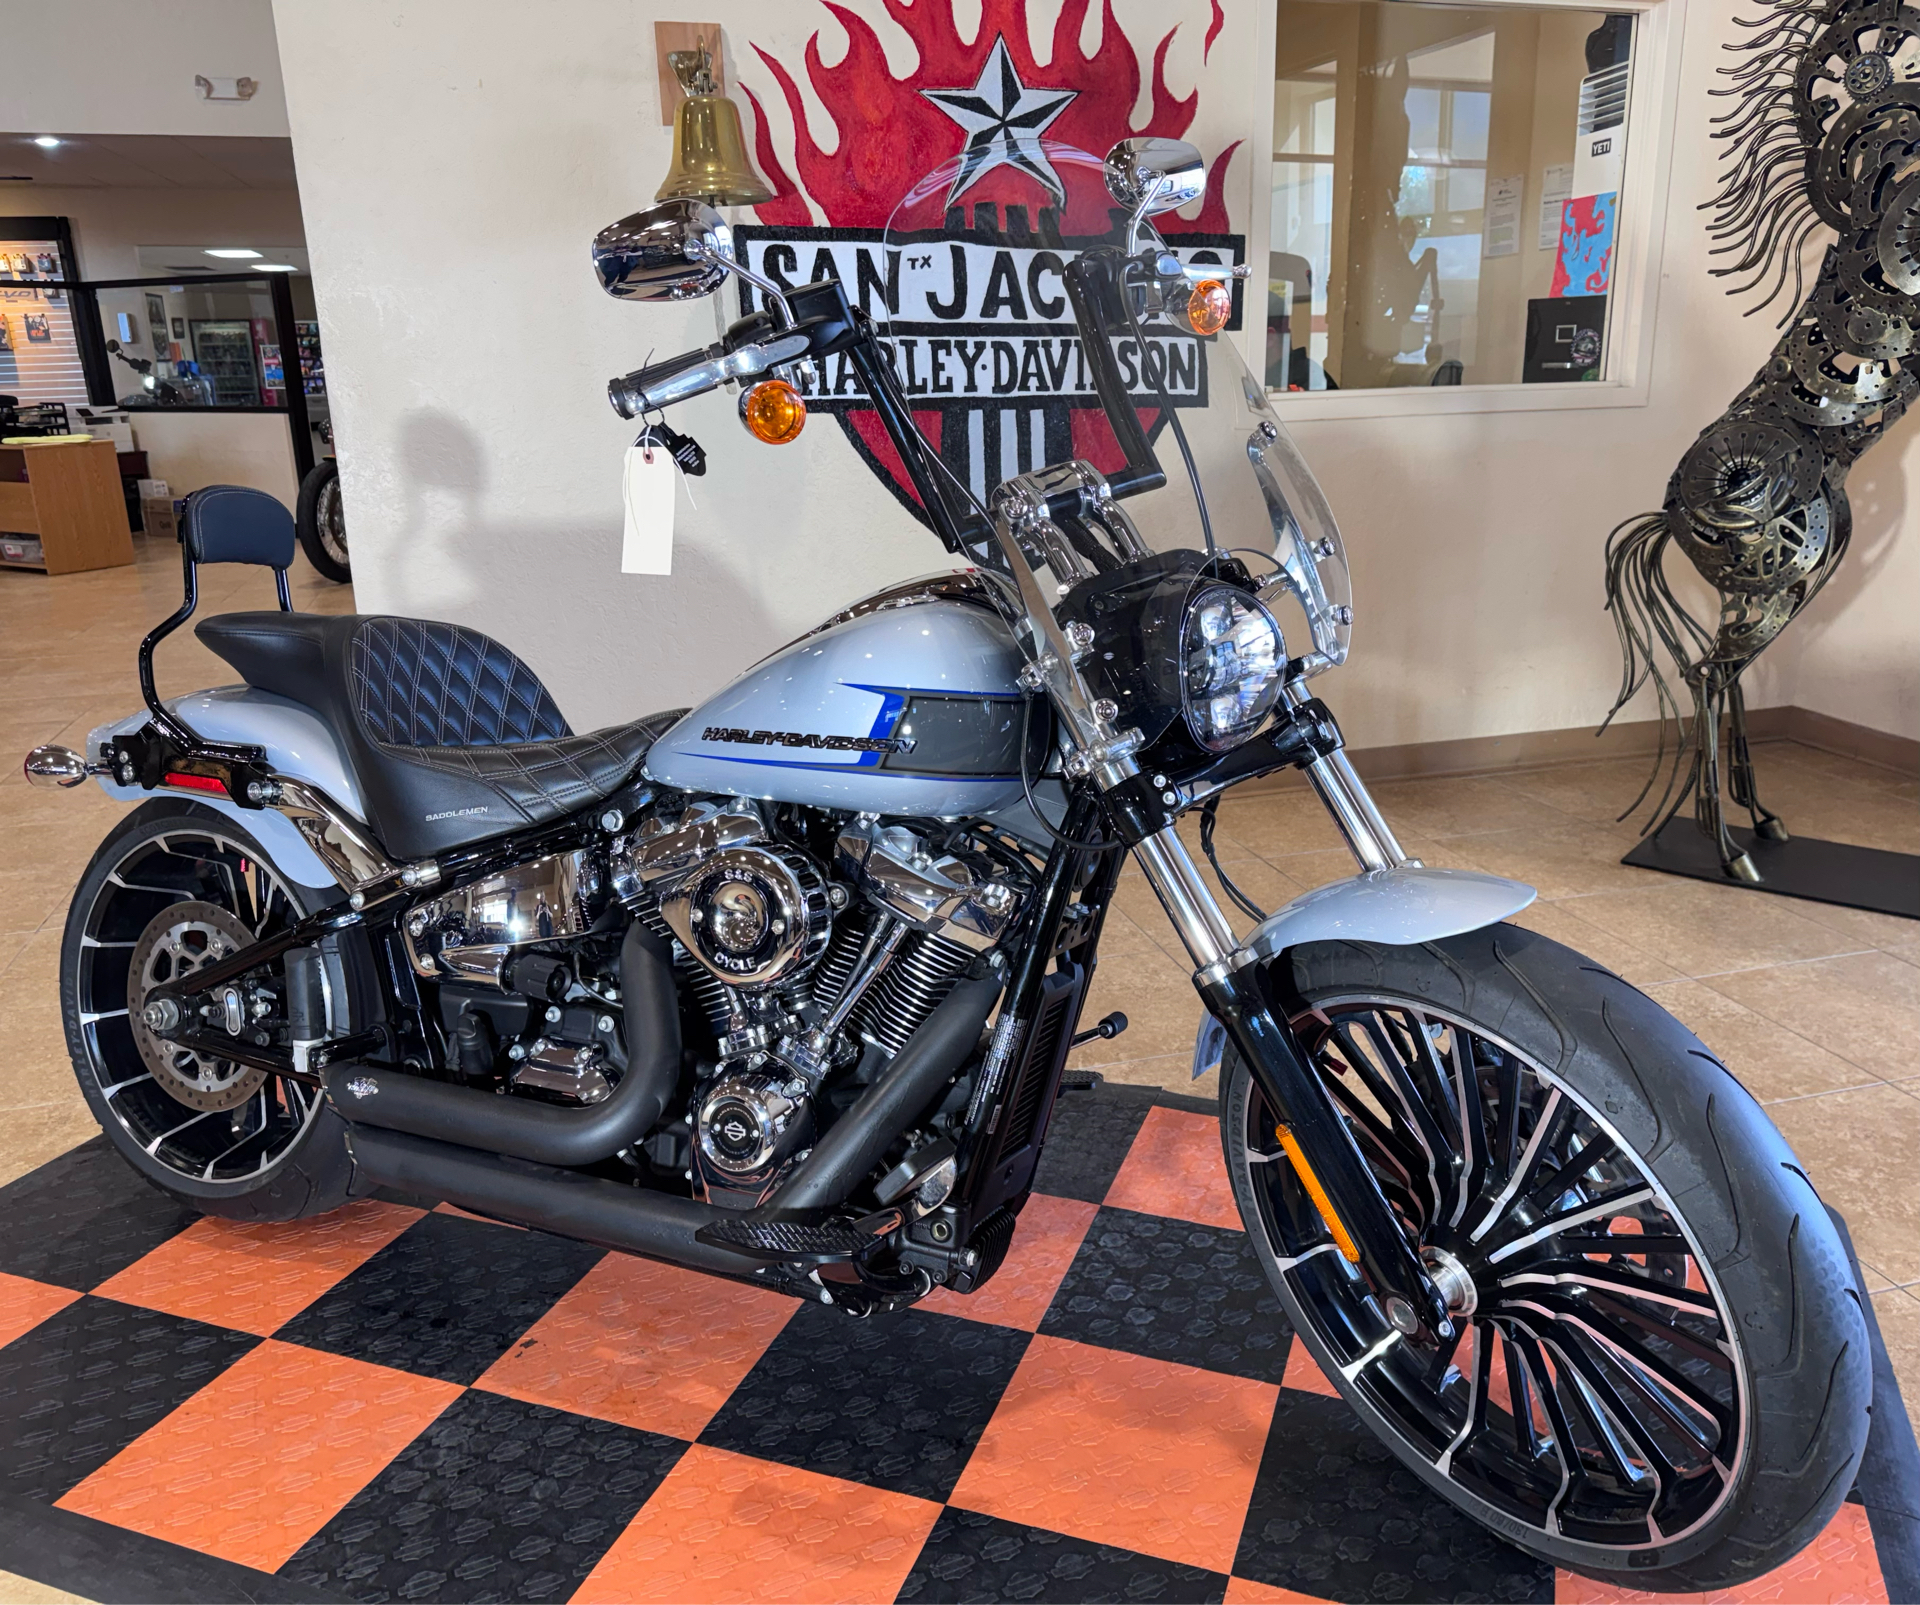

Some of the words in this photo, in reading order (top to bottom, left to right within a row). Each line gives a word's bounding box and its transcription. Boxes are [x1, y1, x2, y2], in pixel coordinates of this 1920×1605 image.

[1593, 141, 1611, 155] YETI
[907, 254, 932, 270] TX
[762, 243, 902, 317] SAN
[702, 727, 918, 754] HARLEY-DAVIDSON
[425, 806, 489, 822] SADDLEMEN
[724, 868, 754, 883] S&S
[714, 951, 756, 971] CYCLE
[64, 946, 100, 1099] HARLEY-DAVID
